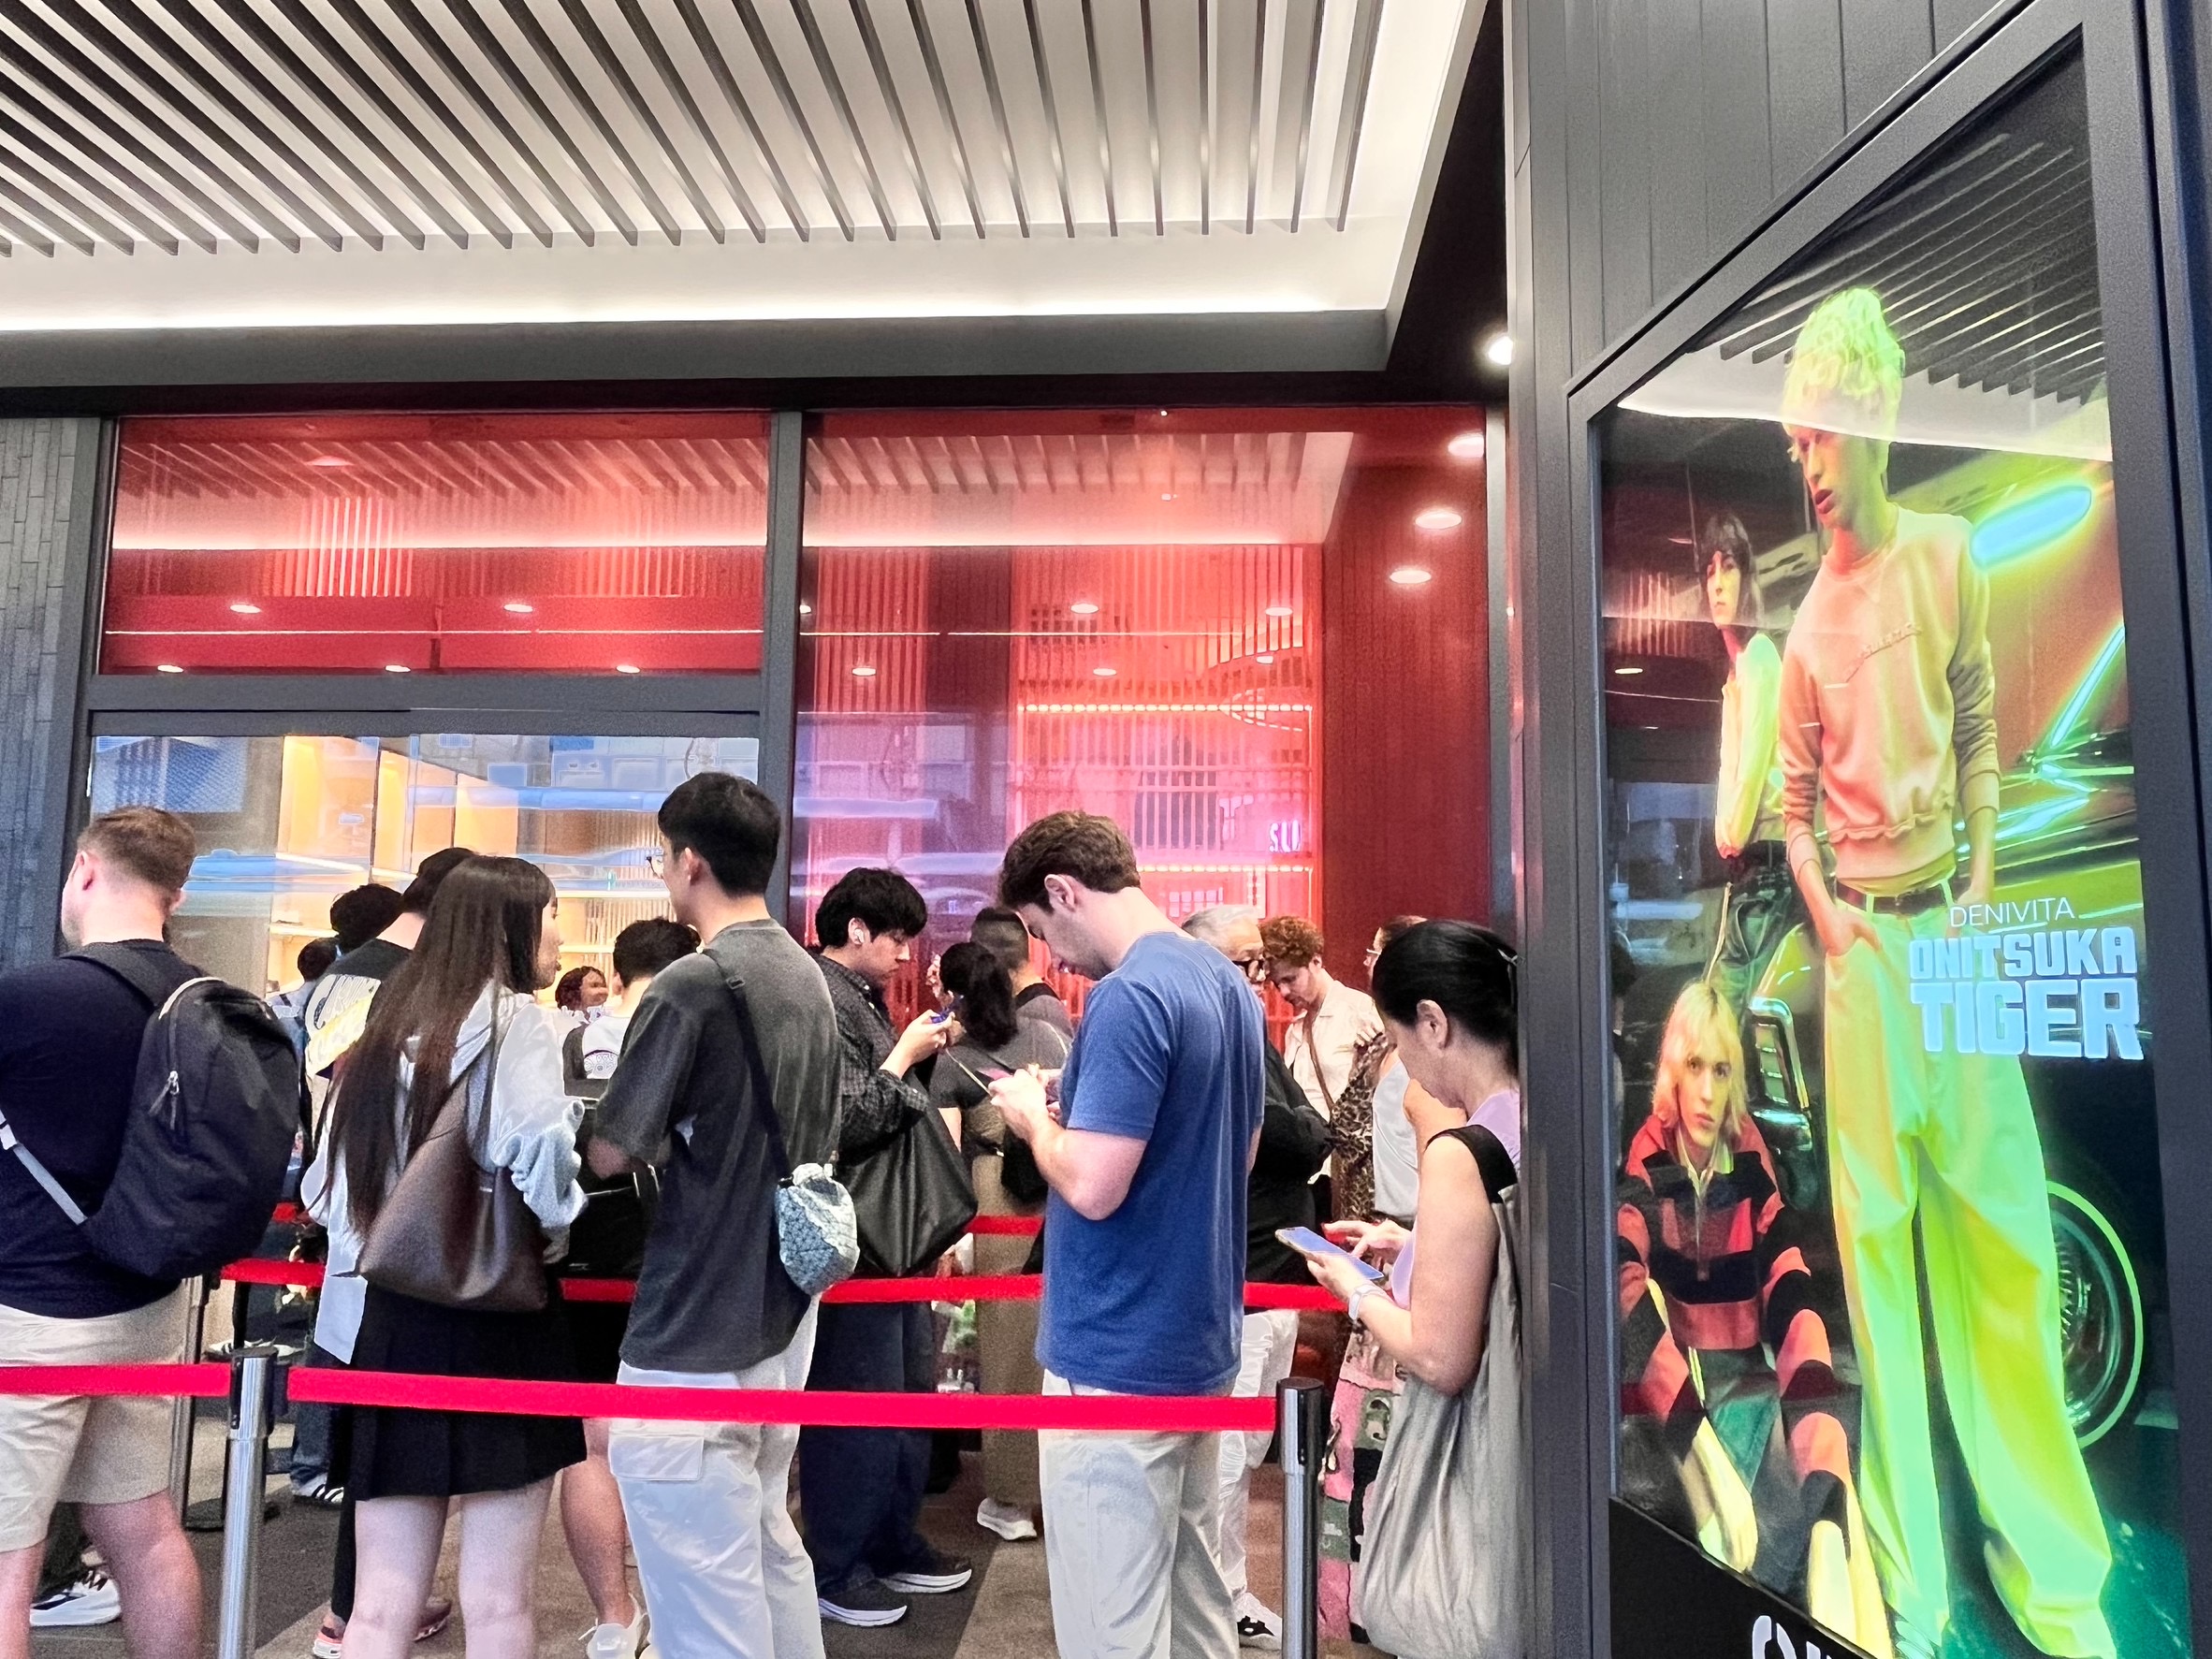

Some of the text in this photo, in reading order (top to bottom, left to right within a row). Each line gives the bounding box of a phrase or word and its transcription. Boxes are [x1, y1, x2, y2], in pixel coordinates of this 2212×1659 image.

[1949, 896, 2075, 928] DENIVITA
[1909, 926, 2138, 980] ONITSUKA
[1910, 978, 2145, 1061] TIGER
